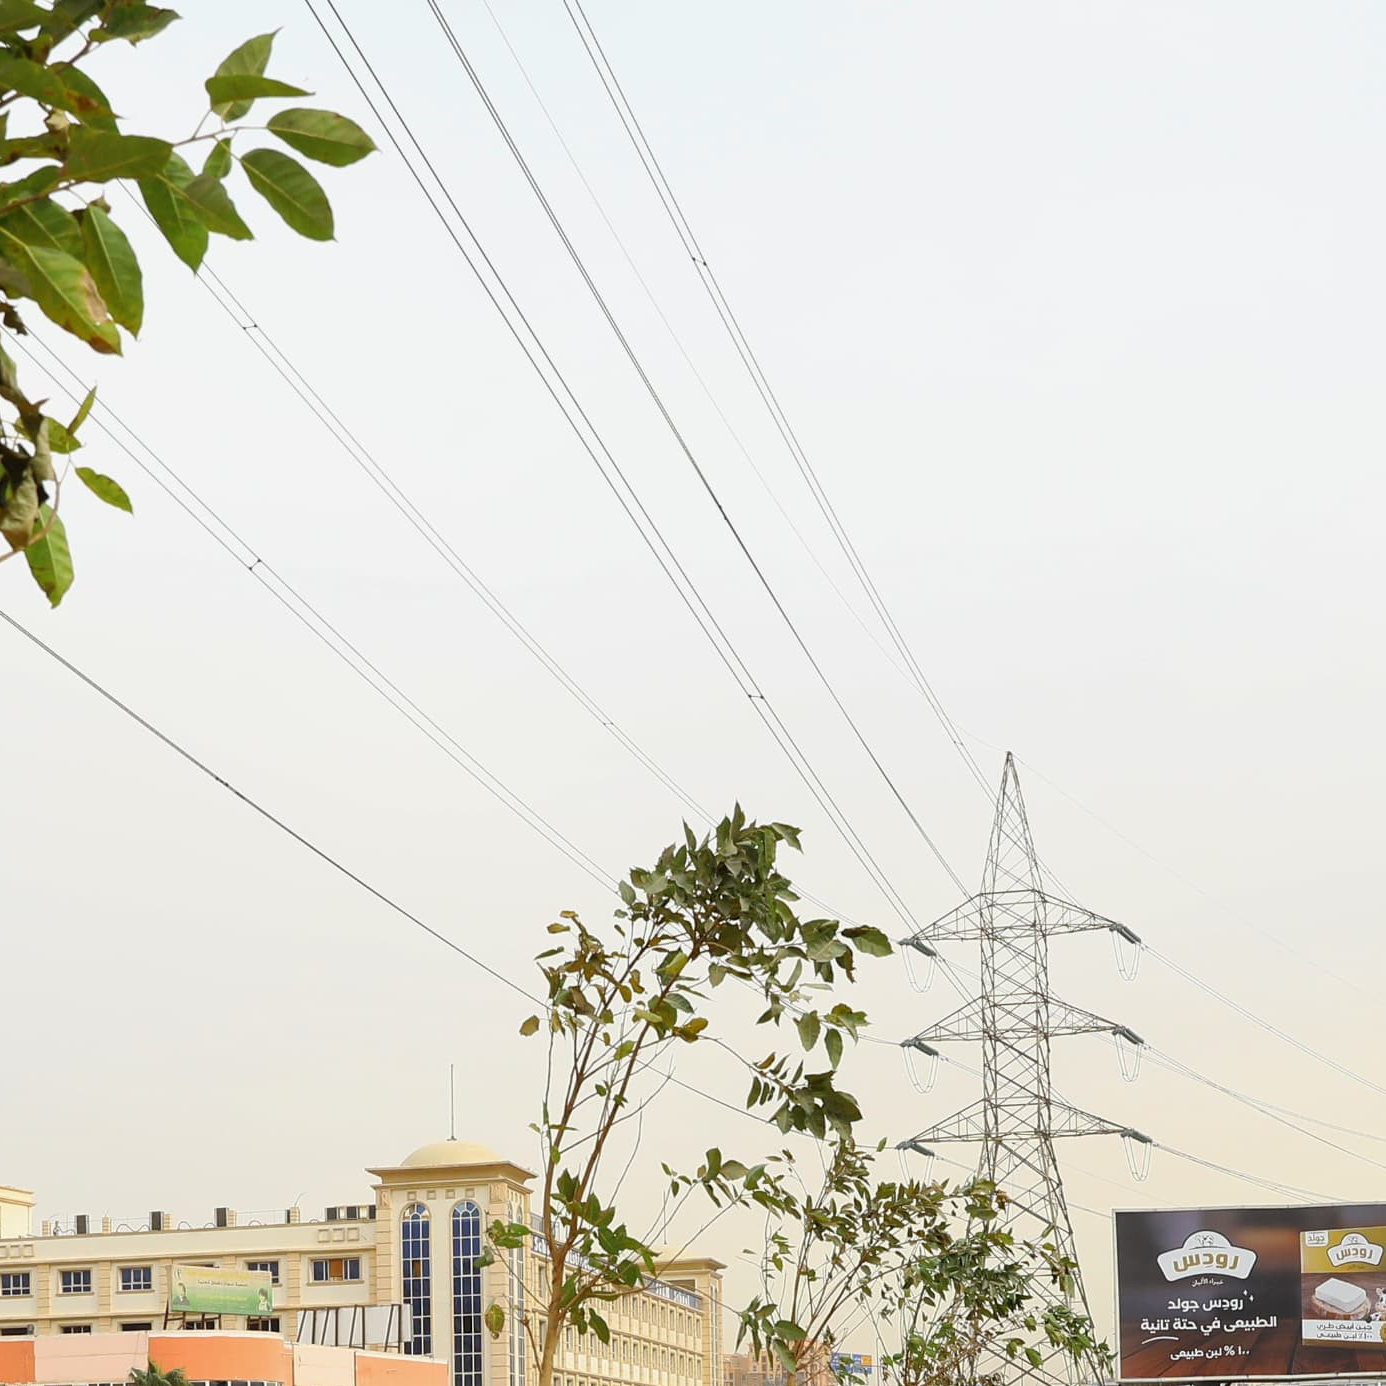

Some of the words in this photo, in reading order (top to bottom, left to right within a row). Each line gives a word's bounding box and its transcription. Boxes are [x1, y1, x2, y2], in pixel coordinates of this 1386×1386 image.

[1167, 1298, 1200, 1312] جولد
[1140, 1318, 1170, 1334] تانية
[1173, 1318, 1198, 1331] حتة
[1205, 1347, 1222, 1359] لبن
